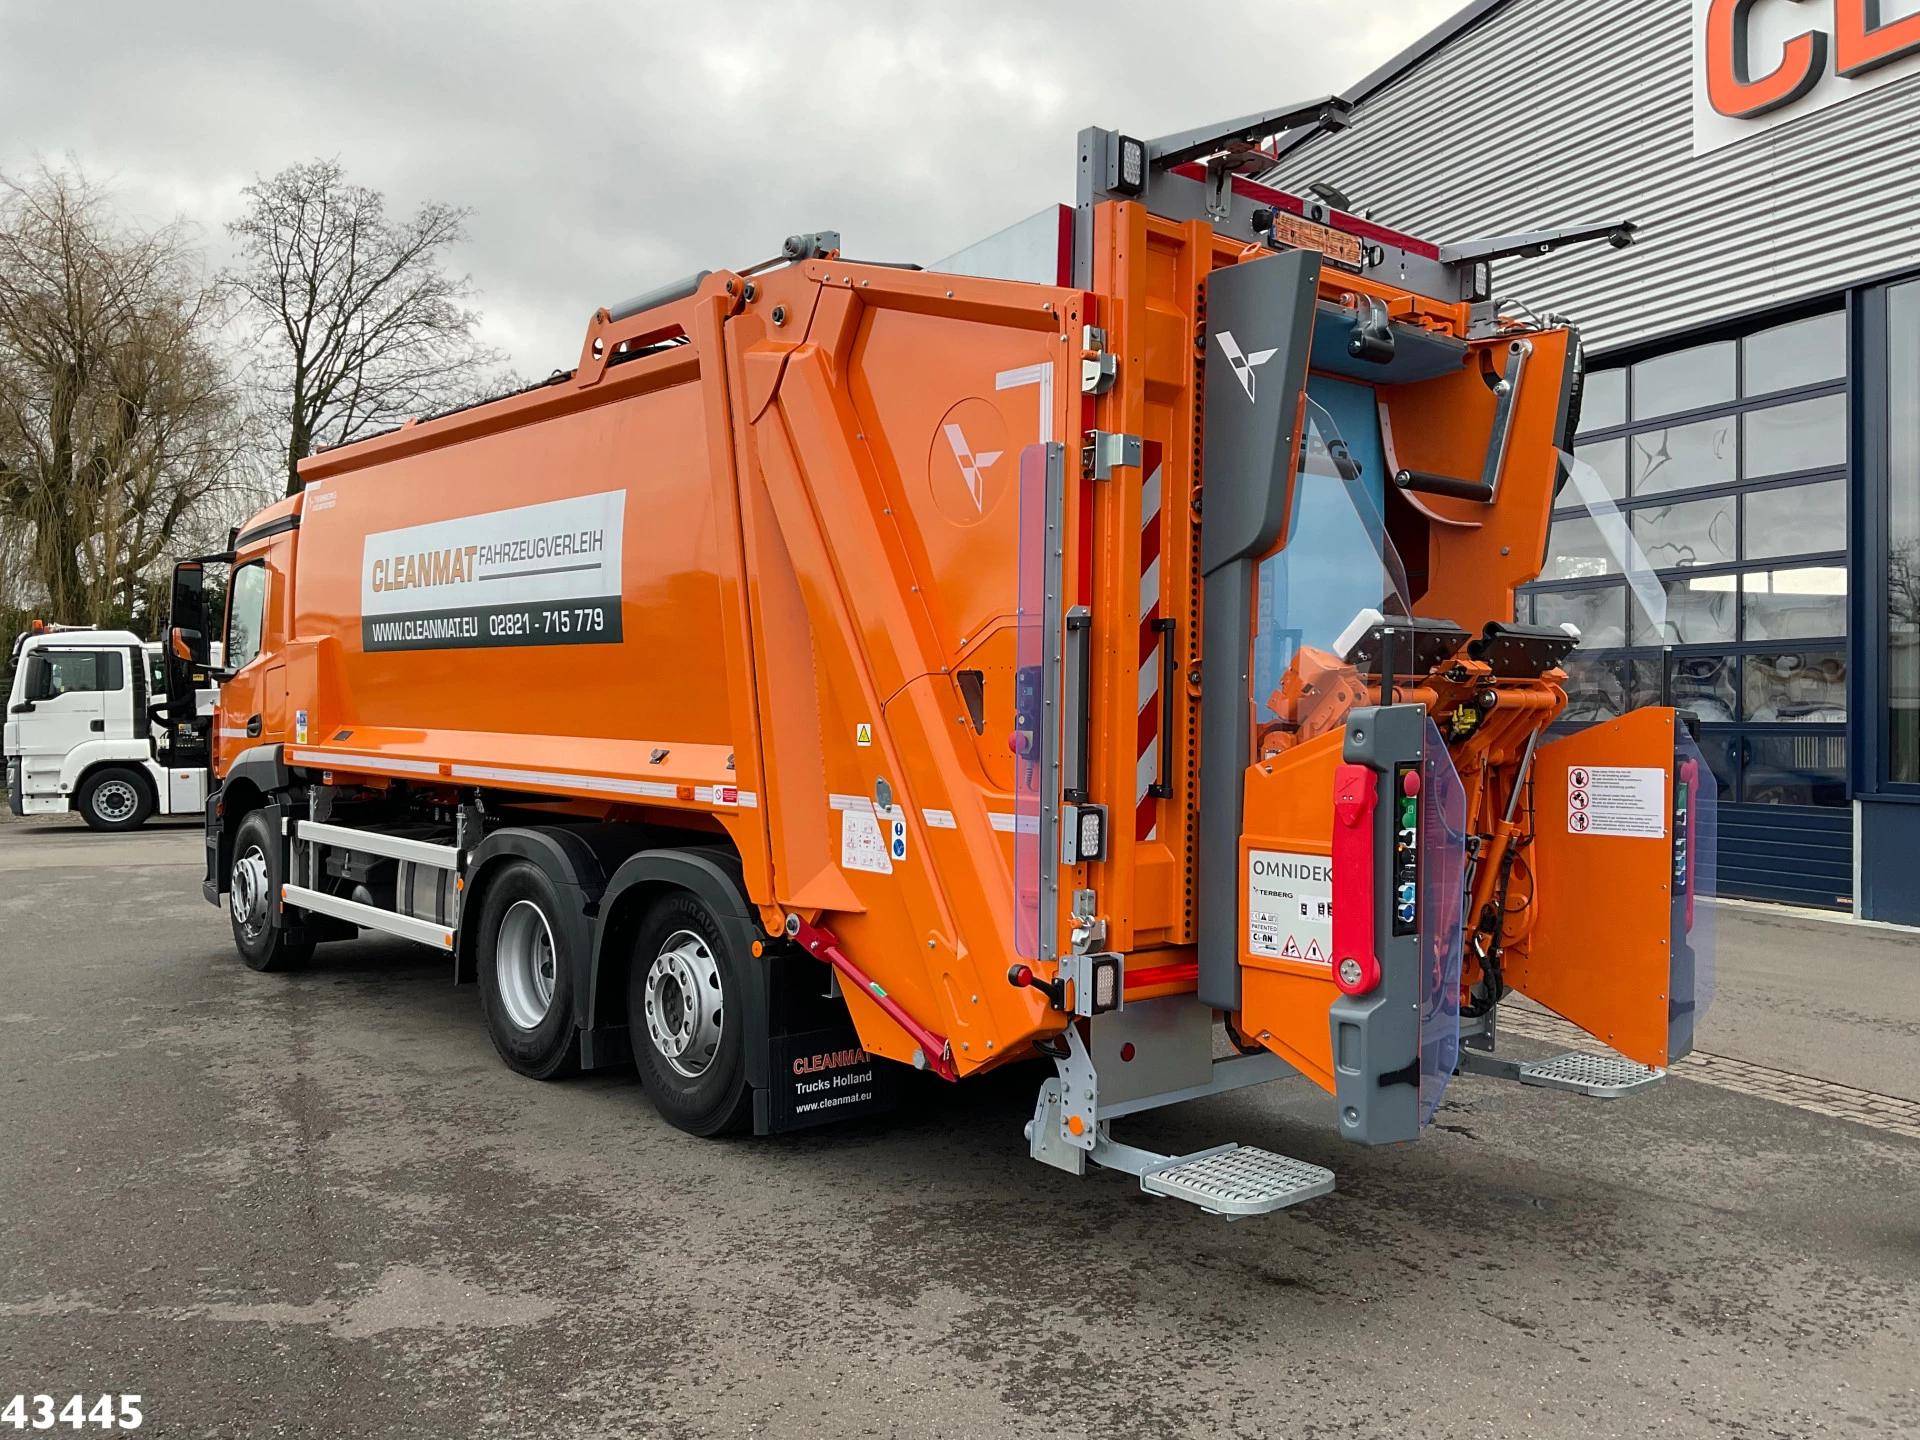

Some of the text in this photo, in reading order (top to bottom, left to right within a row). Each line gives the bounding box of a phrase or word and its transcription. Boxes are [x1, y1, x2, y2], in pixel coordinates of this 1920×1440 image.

[372, 529, 604, 593] CLEANMAT FAHRZEUGVERLEIH
[372, 616, 479, 642] WWW.CLEANMAT.EU
[489, 613, 530, 636] 02821
[542, 610, 570, 634] 715
[575, 607, 604, 633] 779
[1259, 889, 1294, 899] TERBERG
[1251, 923, 1278, 932] PATENTED
[795, 1070, 873, 1095] Trucks Holland
[796, 1092, 872, 1114] www.cleanmat.eu
